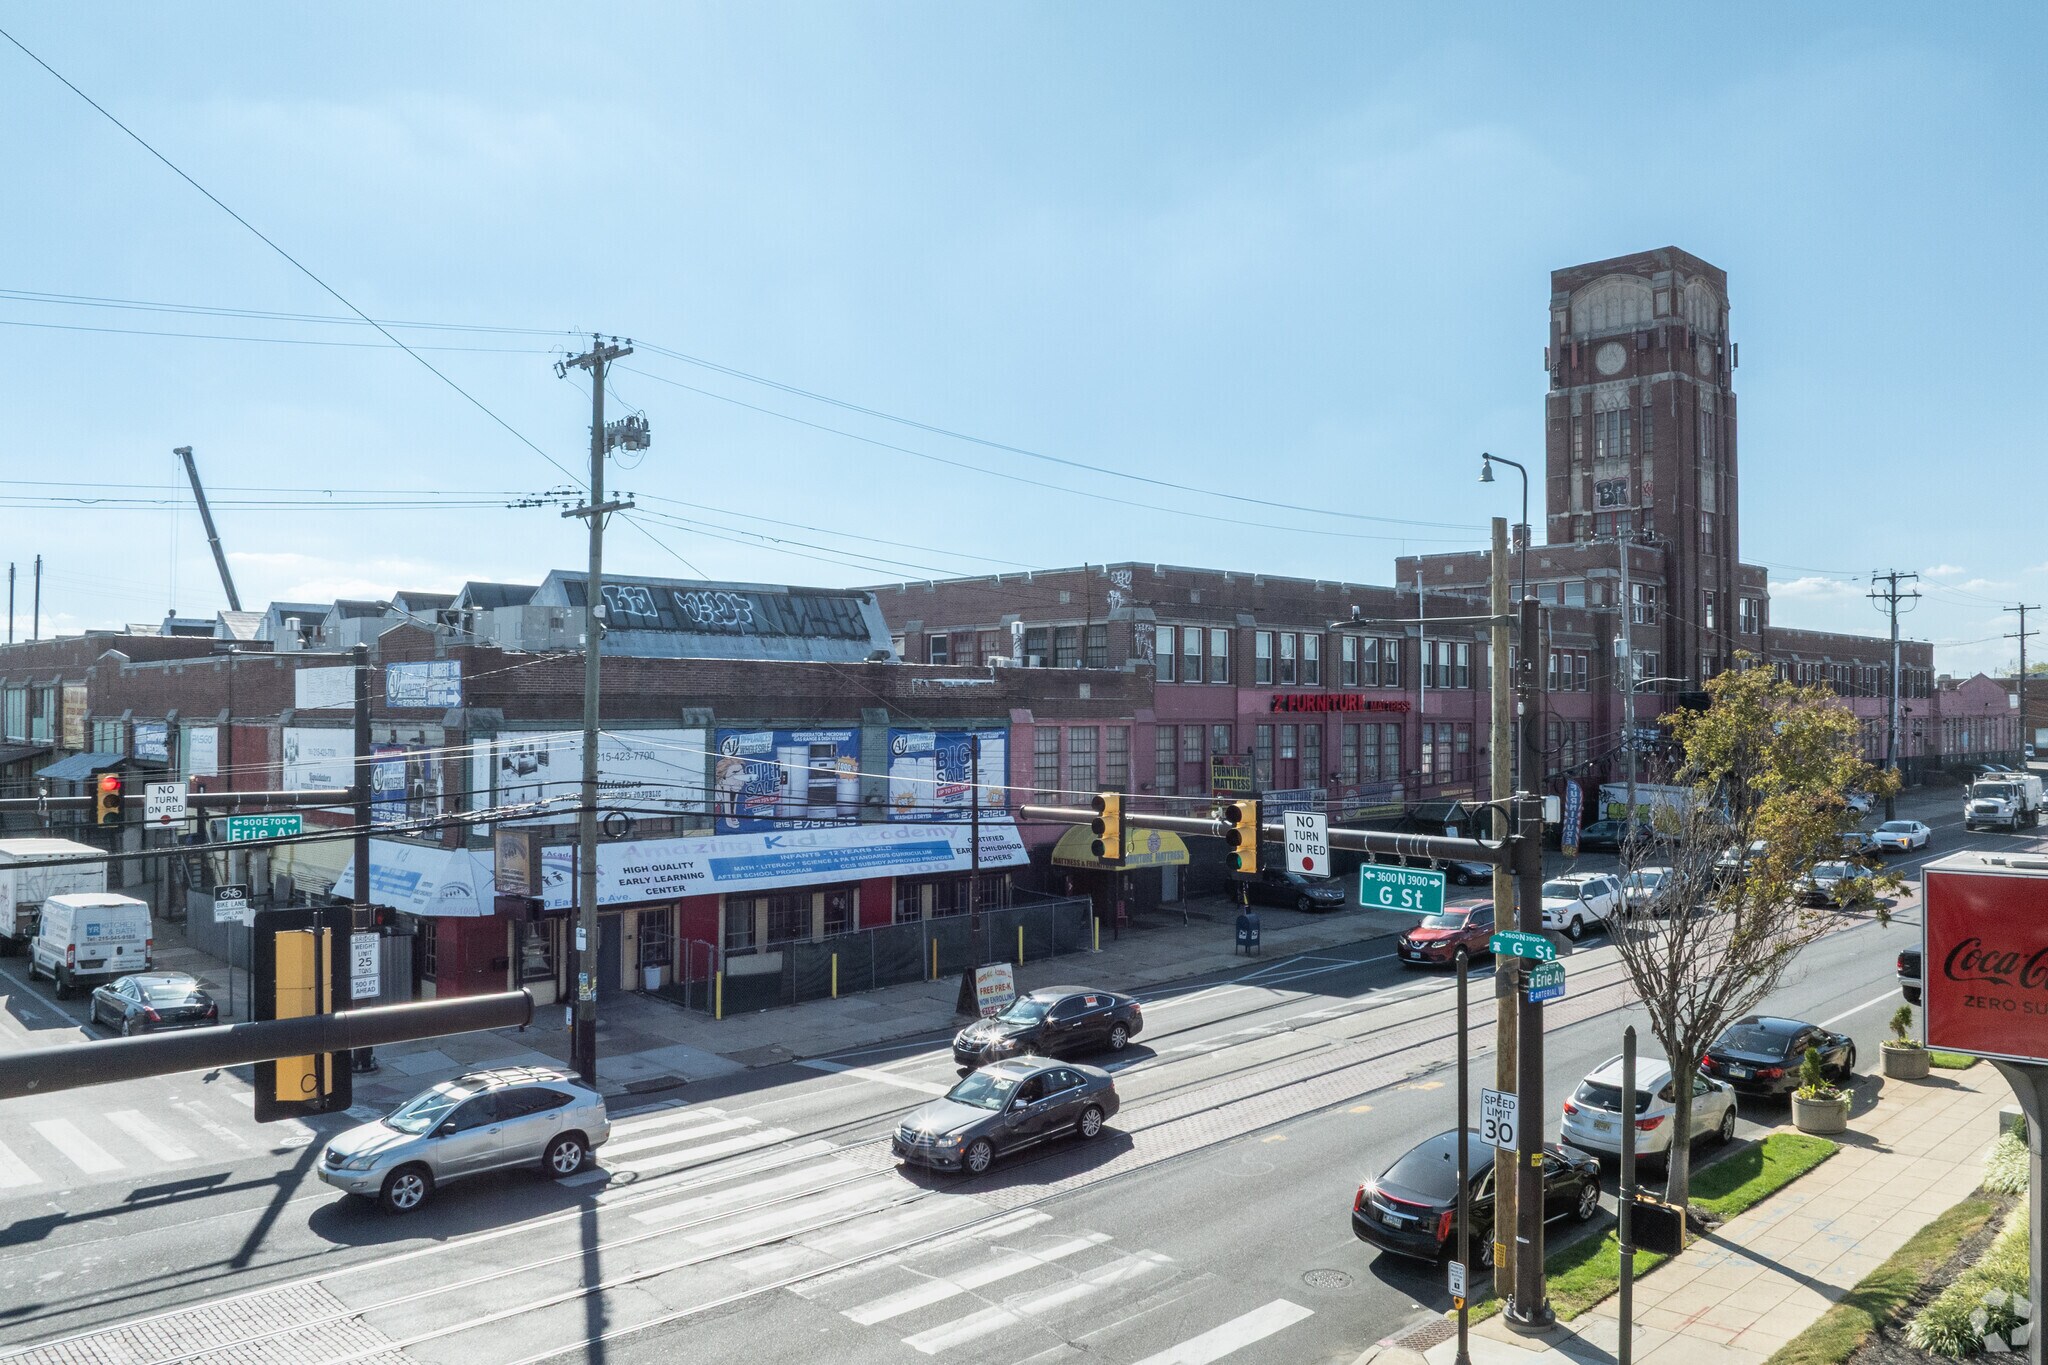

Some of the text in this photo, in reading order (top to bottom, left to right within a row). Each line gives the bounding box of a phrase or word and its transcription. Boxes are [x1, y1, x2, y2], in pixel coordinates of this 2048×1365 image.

[1287, 694, 1365, 713] FURNITURE
[1370, 701, 1412, 712] MATTRESS
[597, 751, 655, 762] 215-423-7700
[935, 743, 971, 771] BIG
[936, 766, 971, 787] SALE
[1214, 766, 1251, 778] FURNITURE
[158, 785, 175, 794] NO
[745, 779, 781, 799] SALE
[1214, 778, 1251, 790] MATTRESS
[155, 796, 178, 804] TURN
[641, 790, 662, 798] PUBLIC
[148, 805, 183, 814] ON RED
[1296, 815, 1314, 828] NO
[232, 827, 268, 842] Erie
[967, 835, 1005, 844] CRTIFIED
[1294, 830, 1319, 841] TURN
[780, 851, 820, 860] INFANTS
[841, 847, 871, 855] YEARS
[980, 843, 1022, 853] CHILDHOOD
[1289, 843, 1326, 855] ON RED
[734, 864, 754, 872] MATH
[760, 861, 796, 870] LITERACY
[802, 858, 832, 866] SCIENCE
[850, 852, 890, 862] STANDARDS
[891, 850, 932, 859] CURRICULUM
[979, 854, 1012, 863] EACHERS
[623, 861, 694, 875] HIGH QUALITY
[717, 873, 742, 881] AFTER
[743, 870, 775, 879] SCHOOL
[776, 867, 812, 876] PROGRAM
[887, 857, 921, 866] APPROVED
[922, 854, 954, 862] PROVIDER
[619, 871, 705, 887] EARLY LEARNING
[1377, 872, 1428, 887] 3600 N 3900
[645, 885, 686, 896] CENTER
[1380, 886, 1423, 909] G St
[88, 926, 100, 934] YR
[101, 920, 136, 930] KITCHEN
[1512, 942, 1552, 960] G St
[358, 957, 372, 967] 25
[1536, 970, 1565, 988] Erie Av
[980, 986, 993, 995] FREE
[1530, 986, 1564, 1001] E ARTERIAL W
[1964, 995, 2016, 1012] ZERO
[1484, 1095, 1515, 1110] SPEED
[1487, 1107, 1511, 1119] LIMIT
[1485, 1119, 1513, 1143] 30
